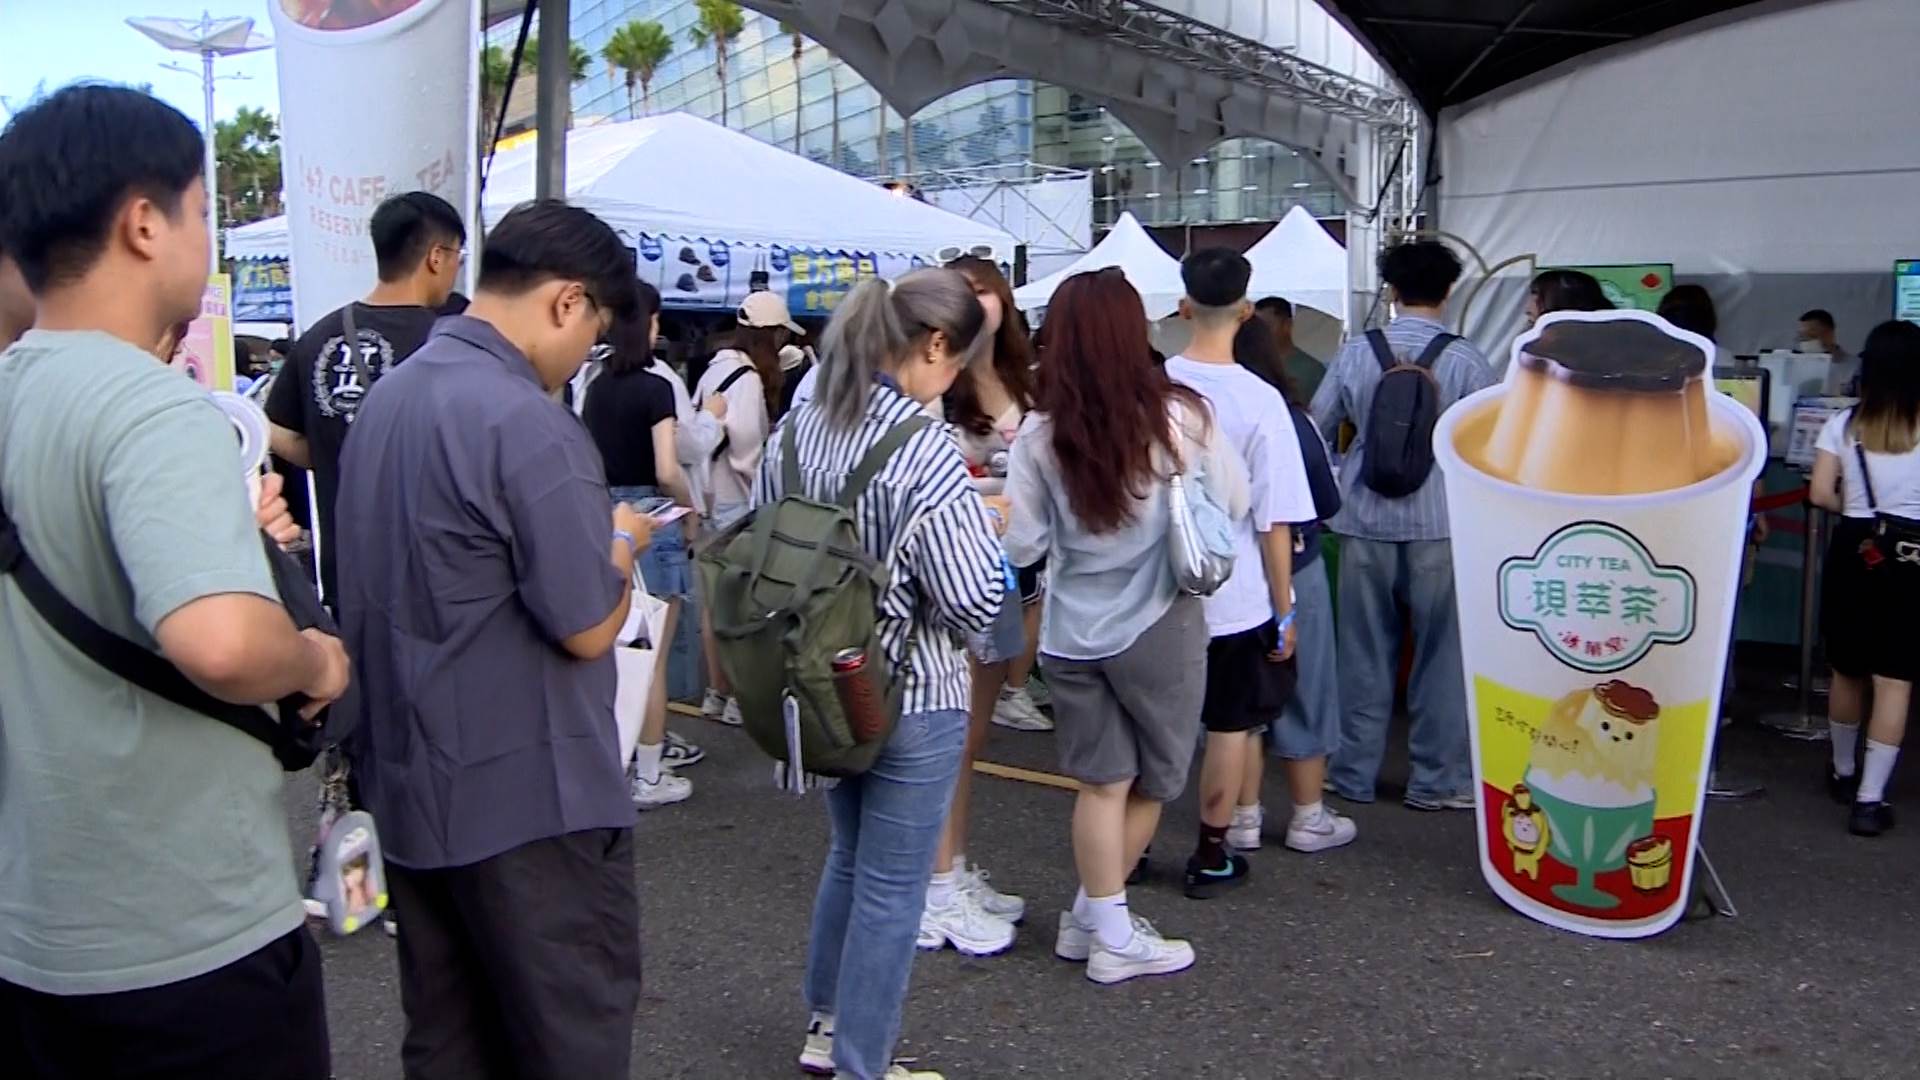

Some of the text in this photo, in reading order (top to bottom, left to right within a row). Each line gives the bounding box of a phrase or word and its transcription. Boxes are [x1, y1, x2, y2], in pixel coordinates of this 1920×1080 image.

[416, 149, 455, 192] TEA
[1556, 554, 1632, 572] CITY TEA
[1531, 577, 1659, 624] 現萃茶
